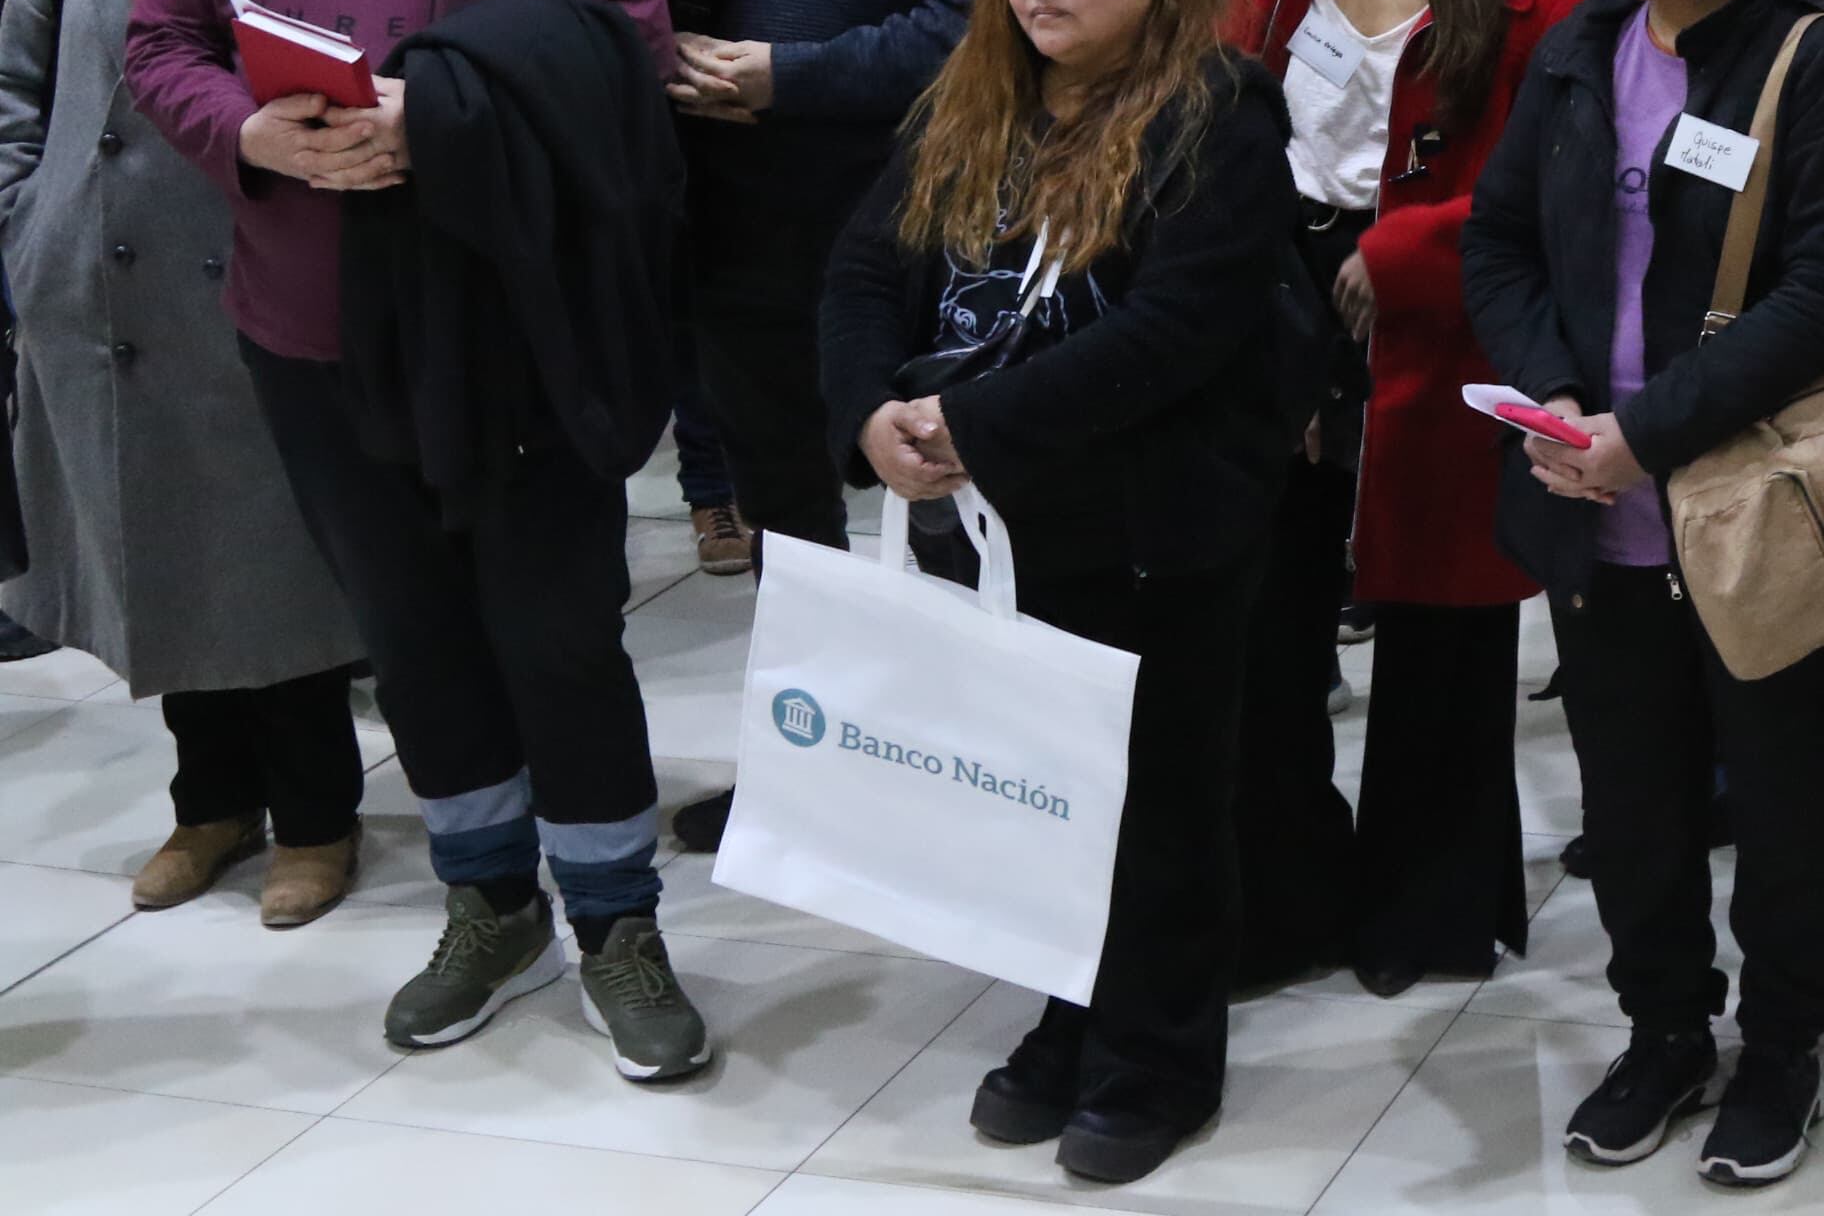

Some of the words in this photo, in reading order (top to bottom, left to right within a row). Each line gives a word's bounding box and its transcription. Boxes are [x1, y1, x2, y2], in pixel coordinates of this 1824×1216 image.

[1693, 131, 1732, 156] Quispe
[838, 721, 944, 776] Banco
[952, 756, 1072, 821] Nación
